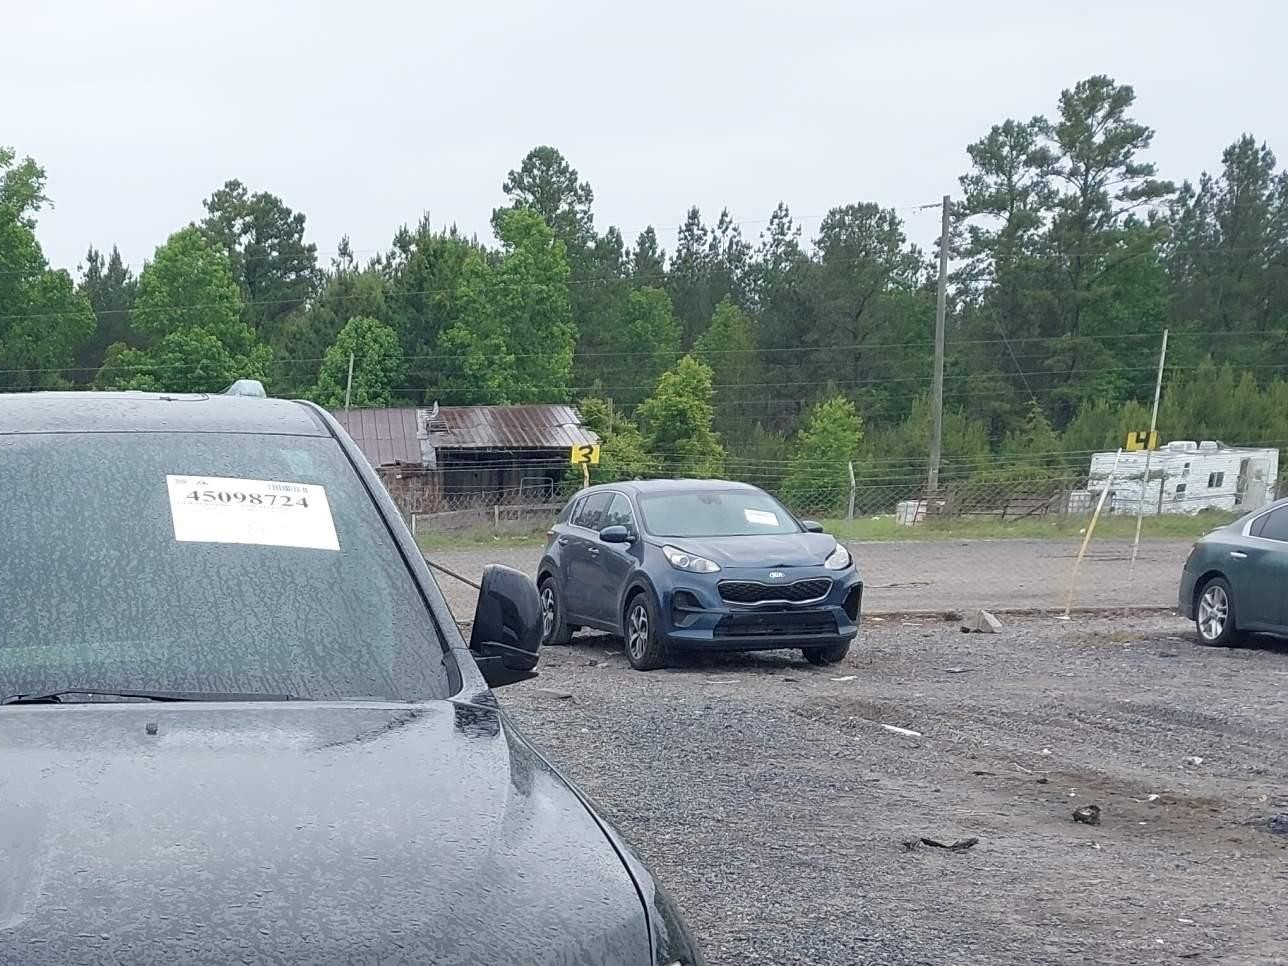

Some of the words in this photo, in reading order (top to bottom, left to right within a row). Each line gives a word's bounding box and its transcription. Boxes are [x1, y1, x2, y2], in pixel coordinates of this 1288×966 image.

[1135, 431, 1151, 450] 4
[578, 444, 594, 464] 3
[187, 490, 309, 508] 45098724
